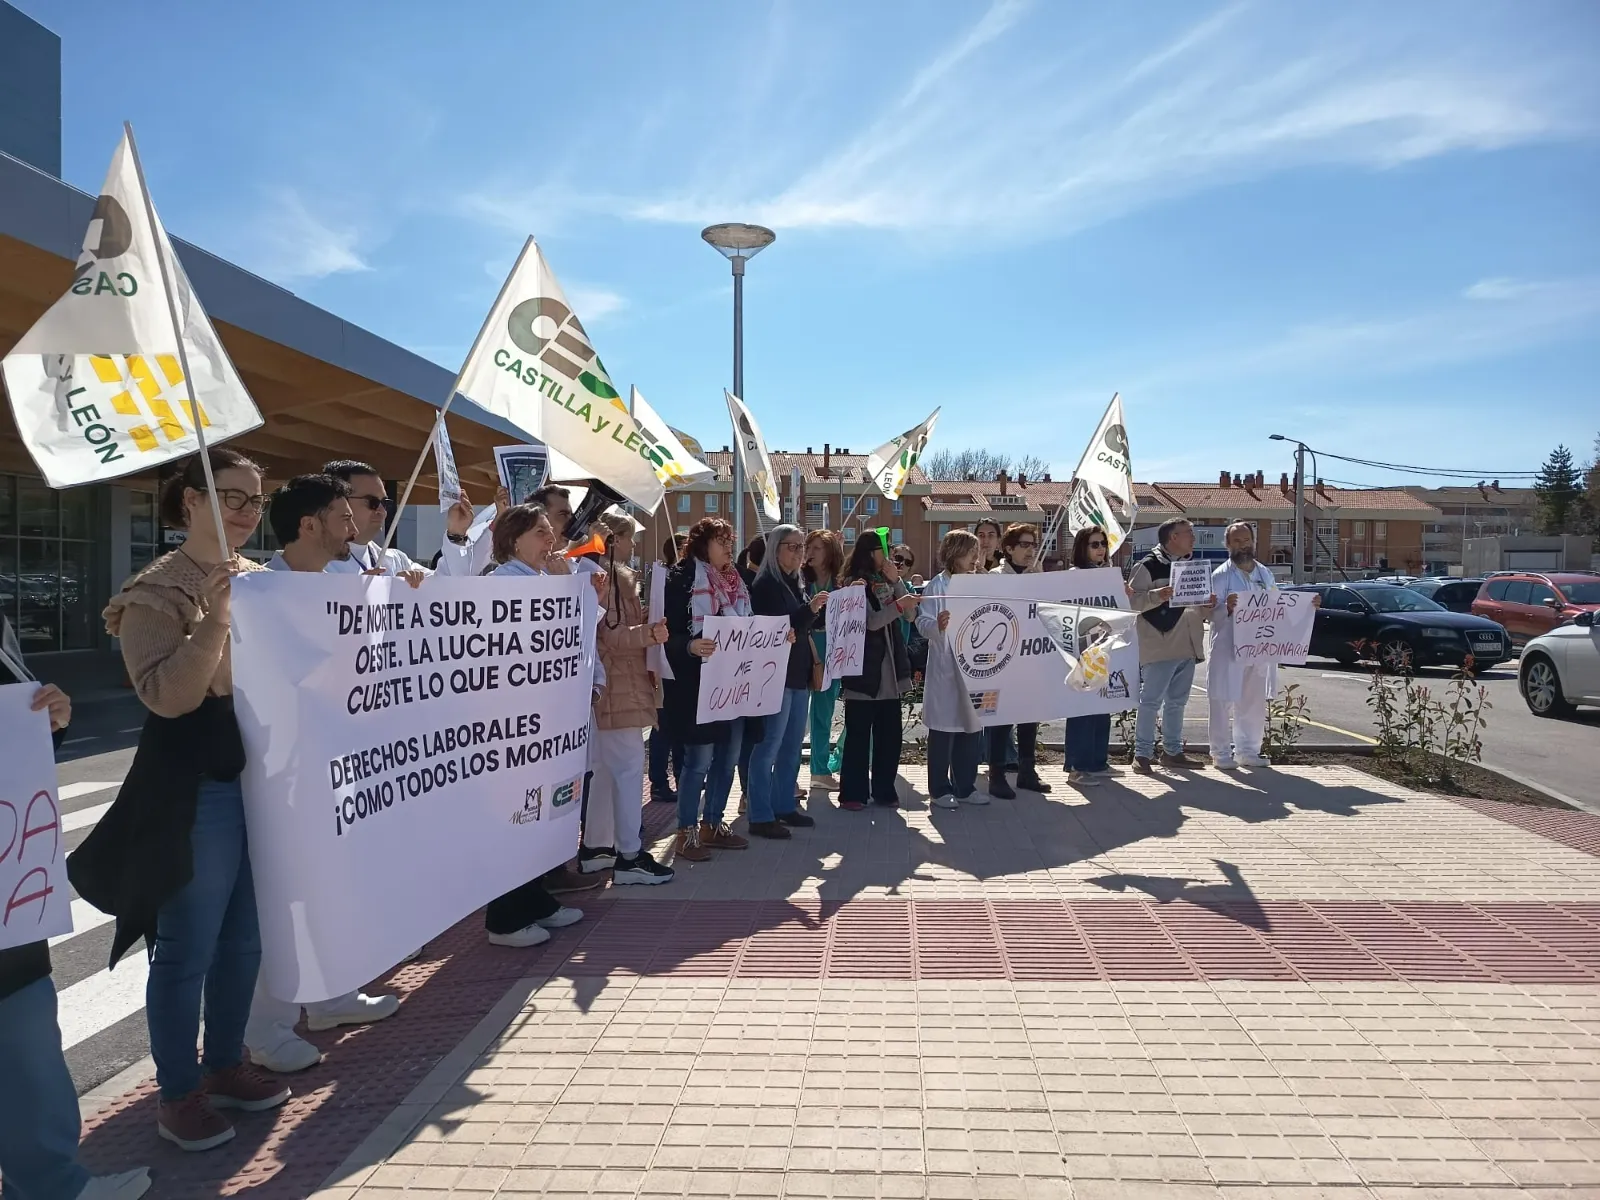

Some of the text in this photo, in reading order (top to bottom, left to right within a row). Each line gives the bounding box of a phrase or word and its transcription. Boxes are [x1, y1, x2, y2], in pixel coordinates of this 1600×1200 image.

[494, 349, 592, 423] CASTILLA
[65, 386, 125, 464] LEÓN
[366, 603, 405, 633] NORTE
[410, 603, 425, 628] A
[429, 600, 482, 628] SUR,
[492, 599, 522, 623] DE
[530, 597, 572, 621] ESTE
[574, 595, 581, 617] A
[1248, 592, 1300, 607] NO ES
[355, 641, 403, 675] OESTE.
[408, 638, 434, 665] LA
[438, 632, 523, 661] LUCHA
[1020, 636, 1057, 656] HORA
[1255, 625, 1275, 639] ES
[347, 676, 413, 715] CUESTE
[418, 672, 444, 700] LO
[450, 665, 499, 694] QUE
[733, 660, 753, 677] ME
[330, 713, 541, 790] DERECHOS LABORALES
[335, 781, 394, 836] ¡COMO
[395, 759, 458, 802] TODOS
[460, 749, 500, 780] LOS
